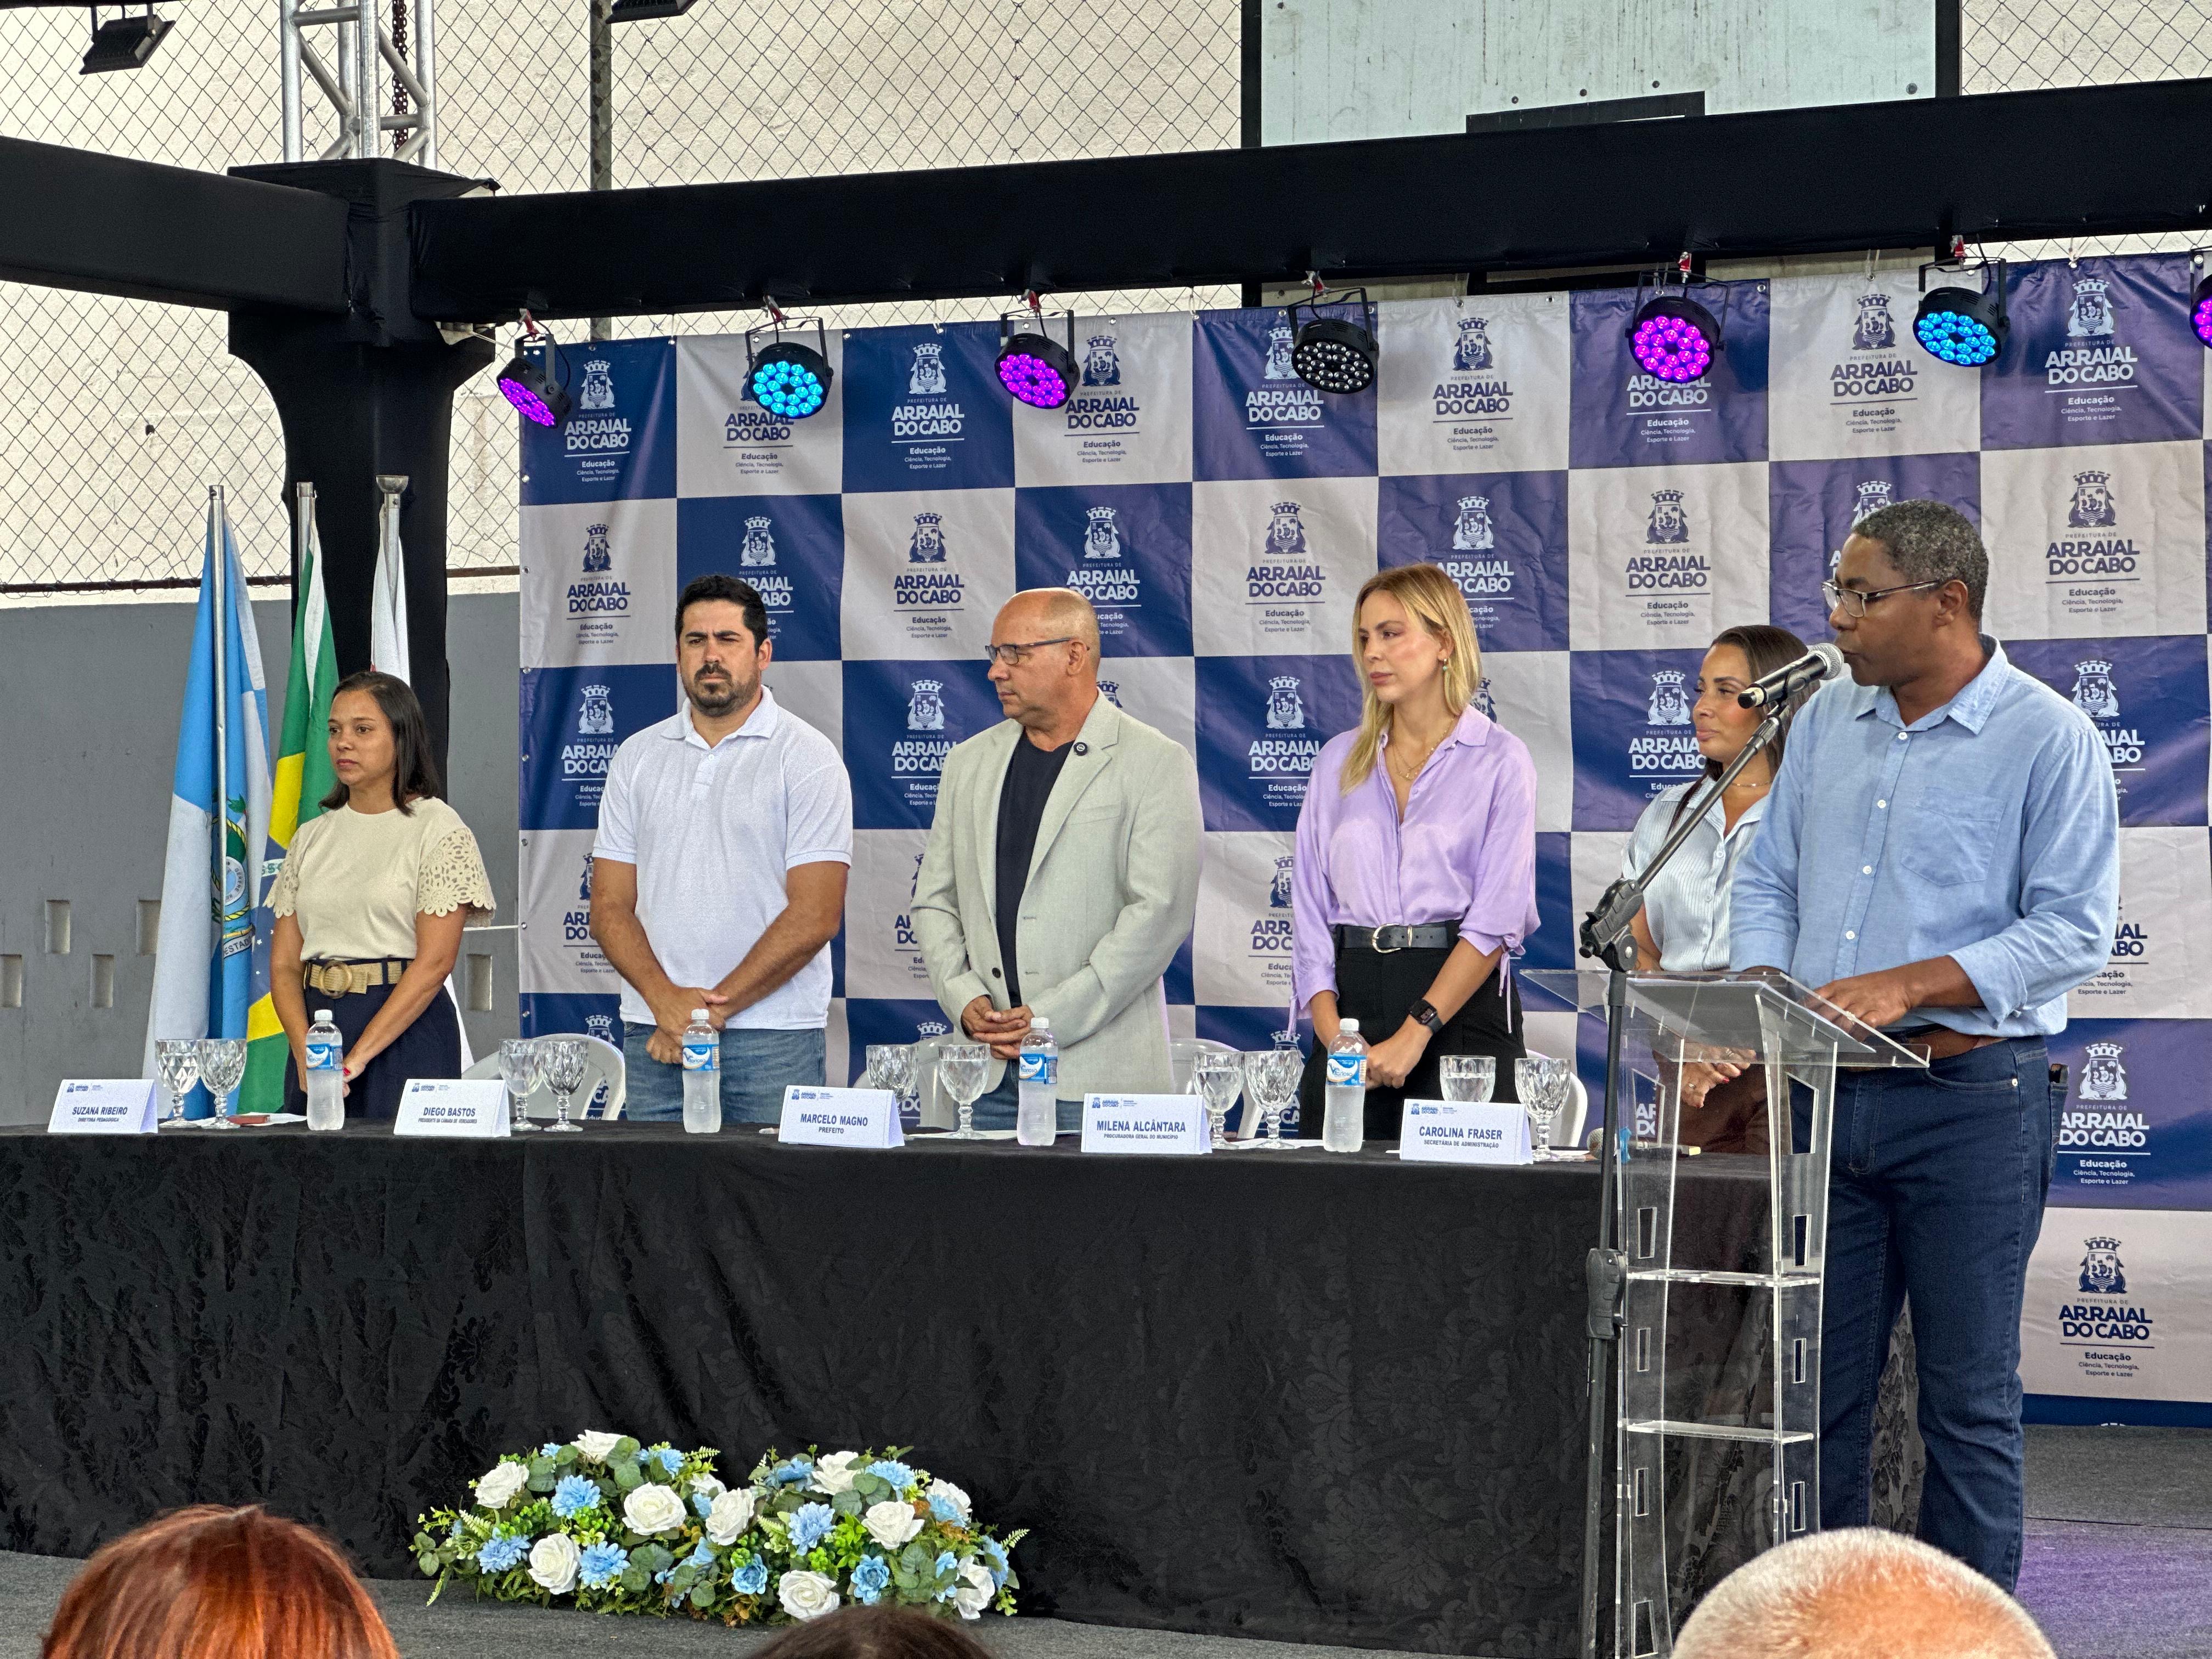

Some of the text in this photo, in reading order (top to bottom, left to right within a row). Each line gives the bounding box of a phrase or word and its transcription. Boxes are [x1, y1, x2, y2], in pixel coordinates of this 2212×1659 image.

[2046, 346, 2138, 367] ARRAIAL
[1832, 360, 1917, 380] ARRAIAL
[2049, 364, 2134, 384] DO CABO
[1434, 381, 1513, 399] ARRAIAL
[1835, 377, 1914, 397] DO CABO
[1245, 390, 1324, 406] ARRAIAL
[1630, 388, 1707, 407] DO CABO
[2069, 395, 2114, 407] Educação
[892, 404, 964, 420] ARRAIAL
[1065, 397, 1139, 414] ARRAIAL
[1437, 397, 1509, 415] DO CABO
[1853, 407, 1895, 419] Educação
[1068, 413, 1136, 429] DO CABO
[1248, 406, 1321, 421] DO CABO
[565, 418, 631, 435] ARRAIAL
[895, 419, 961, 436] DO CABO
[1647, 417, 1689, 428] Educação
[727, 427, 790, 441] DO CABO
[1264, 433, 1303, 443] Educação
[1453, 426, 1492, 437] Educação
[567, 433, 629, 449] DO CABO
[1084, 440, 1120, 450] Educação
[910, 446, 945, 456] Educação
[582, 459, 614, 469] Educação
[2046, 539, 2140, 558] ARRAIAL
[1626, 556, 1711, 572] ARRAIAL
[2050, 557, 2135, 575] DO CABO
[1066, 569, 1140, 585] ARRAIAL
[1246, 566, 1325, 581] ARRAIAL
[1629, 572, 1706, 589] DO CABO
[738, 577, 793, 591] RAIAL
[893, 574, 963, 589] ARRAIAL
[1464, 577, 1510, 592] CABO
[567, 582, 630, 598] ARRAIAL
[896, 589, 961, 604] DO CABO
[1095, 585, 1138, 600] CABO
[1249, 582, 1322, 597] DO CABO
[2069, 587, 2115, 598] Educação
[761, 592, 791, 606] ABO
[1647, 601, 1688, 611] Educação
[912, 616, 946, 625] Educação
[1265, 609, 1304, 618] Educação
[561, 744, 619, 759] ARRAIA
[891, 741, 956, 756] ARRAIA
[1628, 737, 1700, 753] ARRAIA
[565, 760, 588, 774] DO
[895, 757, 918, 771] DO
[1251, 757, 1277, 771] DO
[1632, 754, 1658, 770] DO
[1268, 784, 1307, 793] Educação
[72, 1107, 128, 1115] SUZANA RIBEIRO
[424, 1107, 476, 1116] DIEGO BASTOS
[800, 1114, 868, 1126] MARCELO MAGNO
[1097, 1119, 1186, 1132] MILENA ALCÂNTARA
[2061, 1112, 2149, 1130] ARRAIAL
[1419, 1126, 1502, 1139] CAROLINA FRASER
[2059, 1129, 2146, 1147] DO CABO
[2080, 1159, 2127, 1169] Educação
[2058, 1305, 2153, 1323] ARRAIAL
[2063, 1322, 2149, 1340] DO CABO
[2085, 1352, 2131, 1362] Educação
